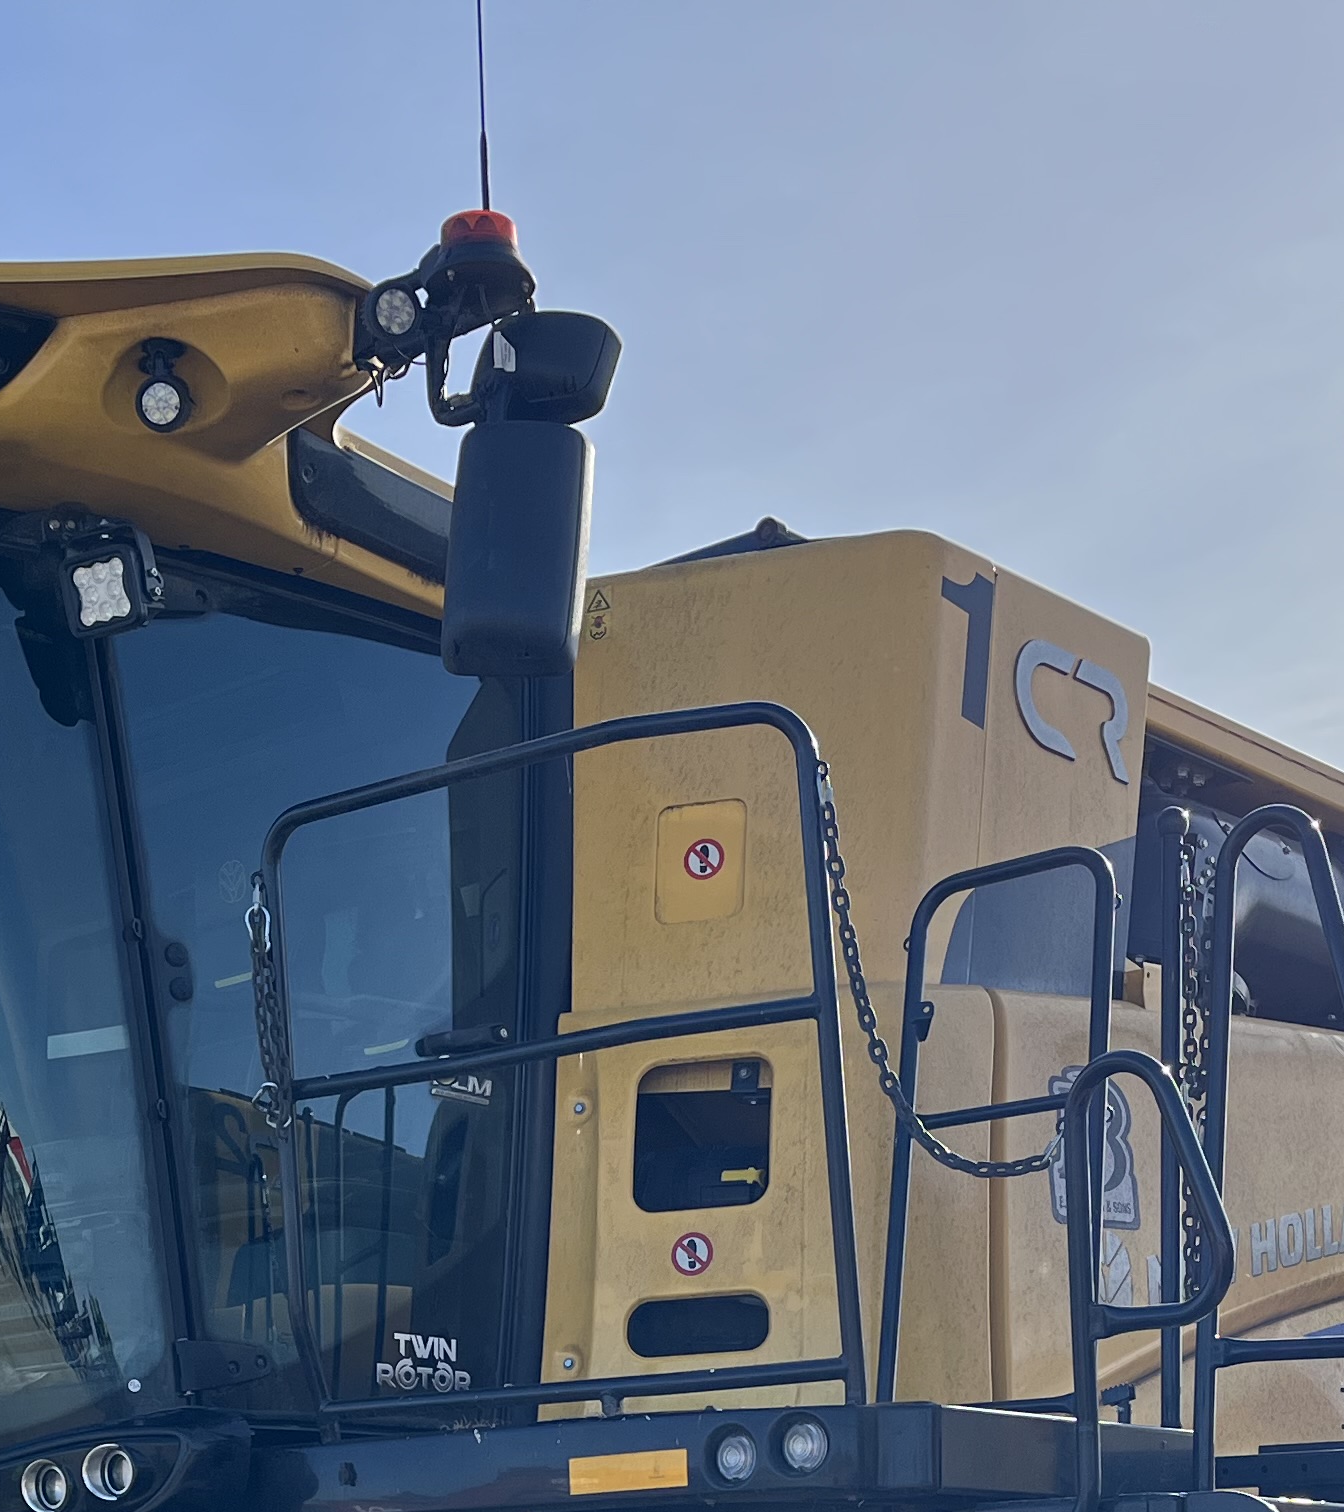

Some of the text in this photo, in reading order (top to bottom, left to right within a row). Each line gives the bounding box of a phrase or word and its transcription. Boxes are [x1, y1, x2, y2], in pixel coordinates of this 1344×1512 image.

[941, 572, 994, 731] 1
[1013, 639, 1130, 786] CR
[432, 1075, 492, 1097] LM
[394, 1333, 457, 1362] TWIN
[376, 1357, 471, 1393] ROTOR
